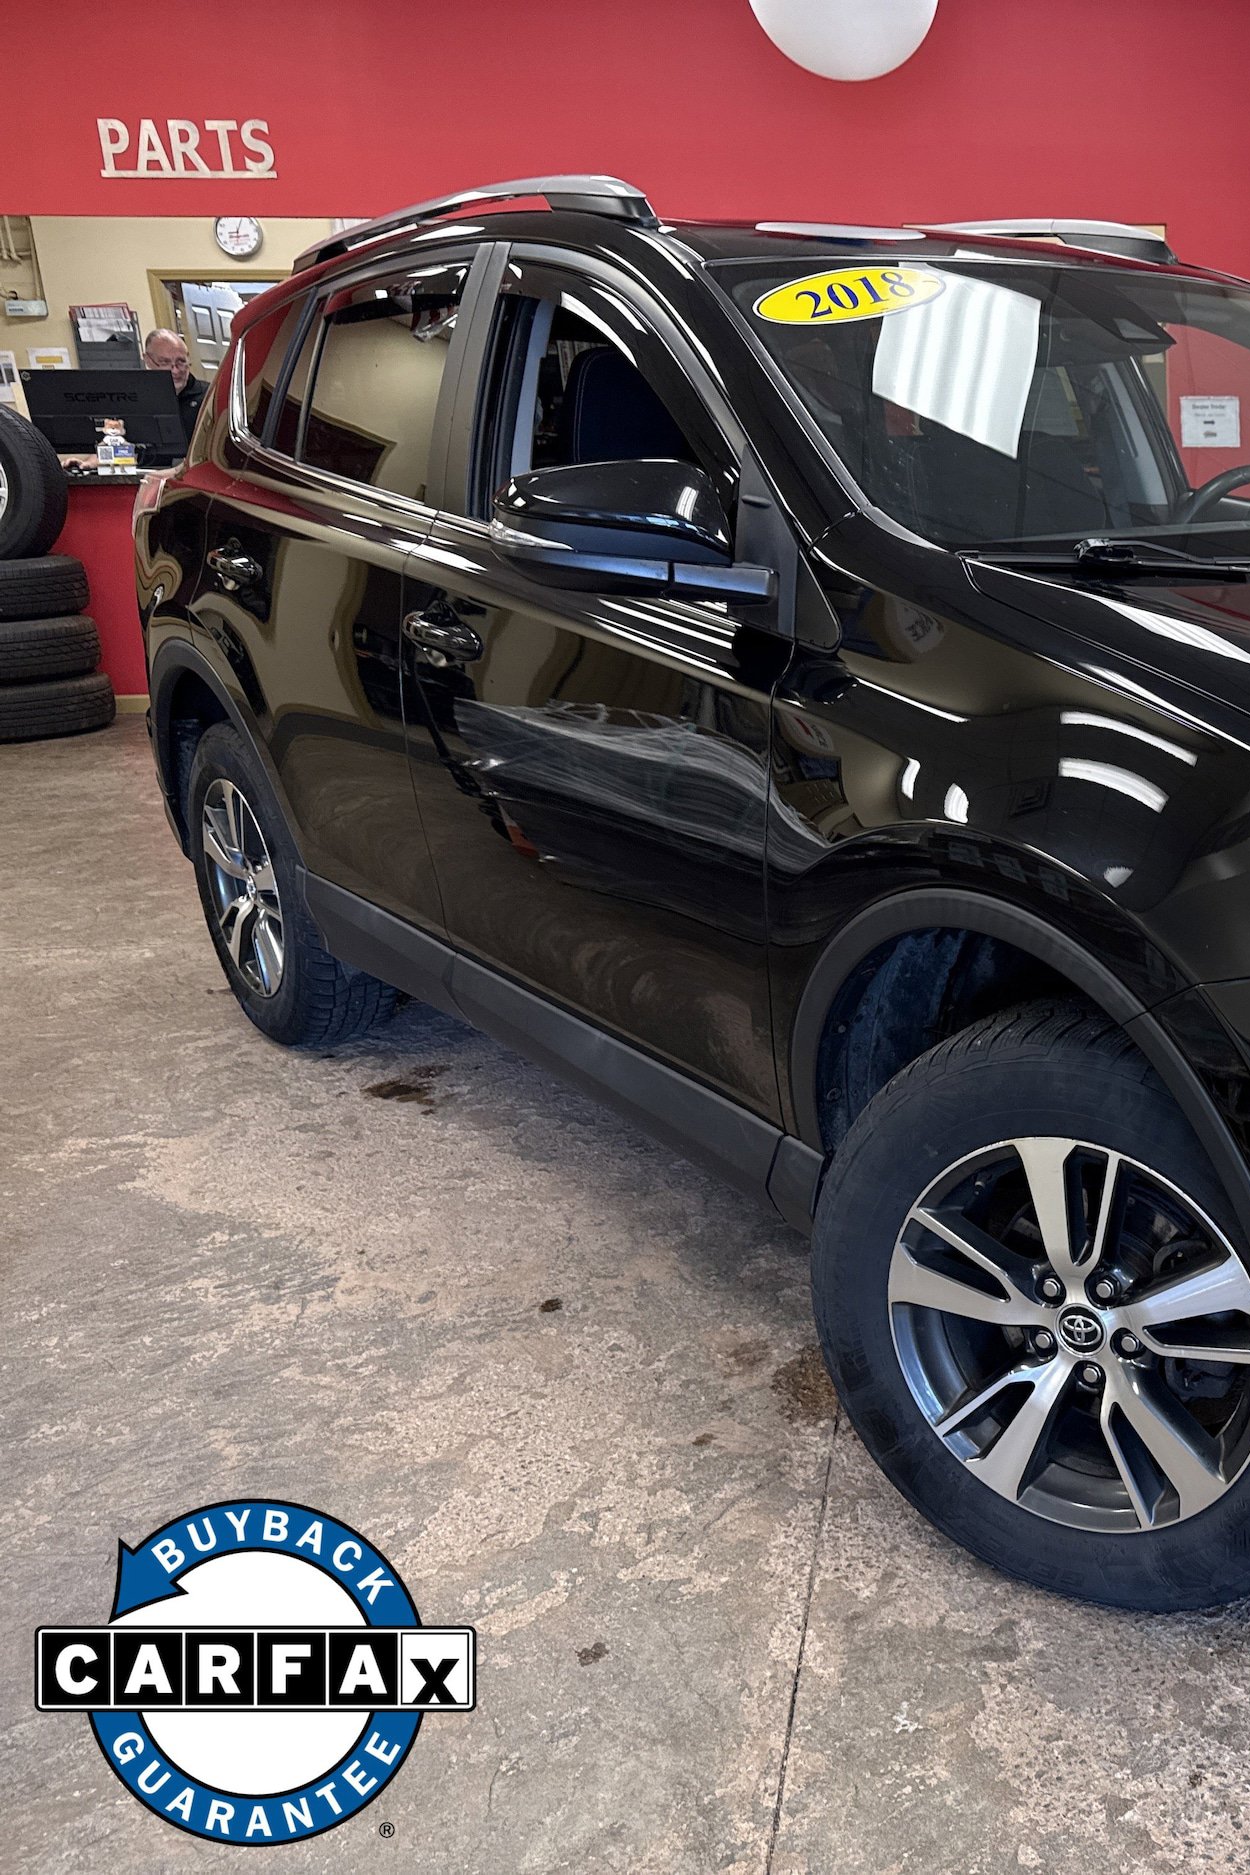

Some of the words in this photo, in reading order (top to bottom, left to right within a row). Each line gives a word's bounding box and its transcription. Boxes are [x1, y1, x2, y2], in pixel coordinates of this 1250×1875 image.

[97, 118, 277, 178] PARTS
[795, 272, 915, 318] 2018
[63, 392, 138, 402] SCEPTRE
